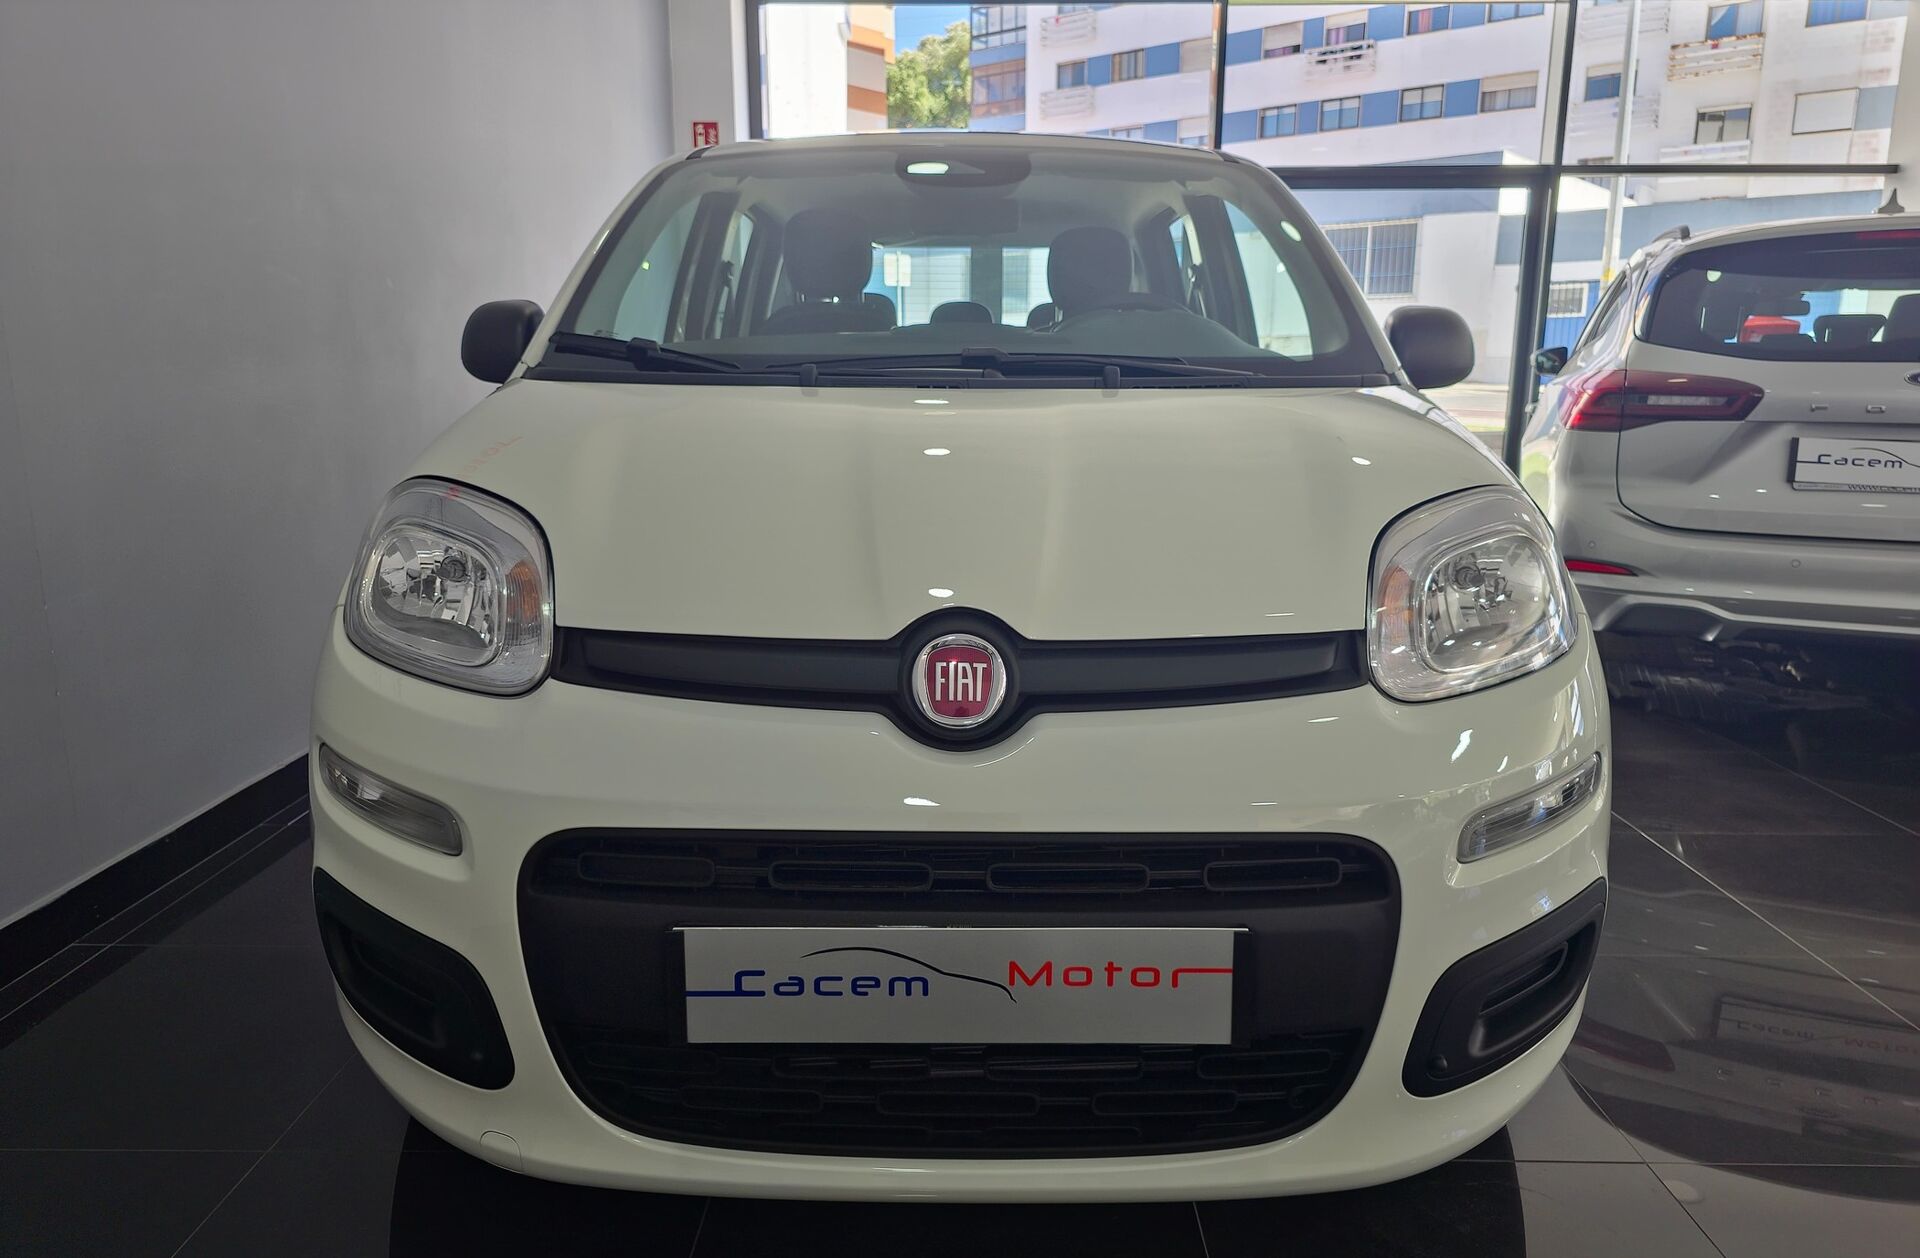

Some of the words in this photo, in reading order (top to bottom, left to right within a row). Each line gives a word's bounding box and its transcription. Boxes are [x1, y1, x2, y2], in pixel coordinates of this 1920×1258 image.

[1816, 453, 1904, 469] Cacem
[935, 661, 988, 702] FIAT
[733, 969, 929, 997] Cacem
[1008, 960, 1232, 989] Motor
